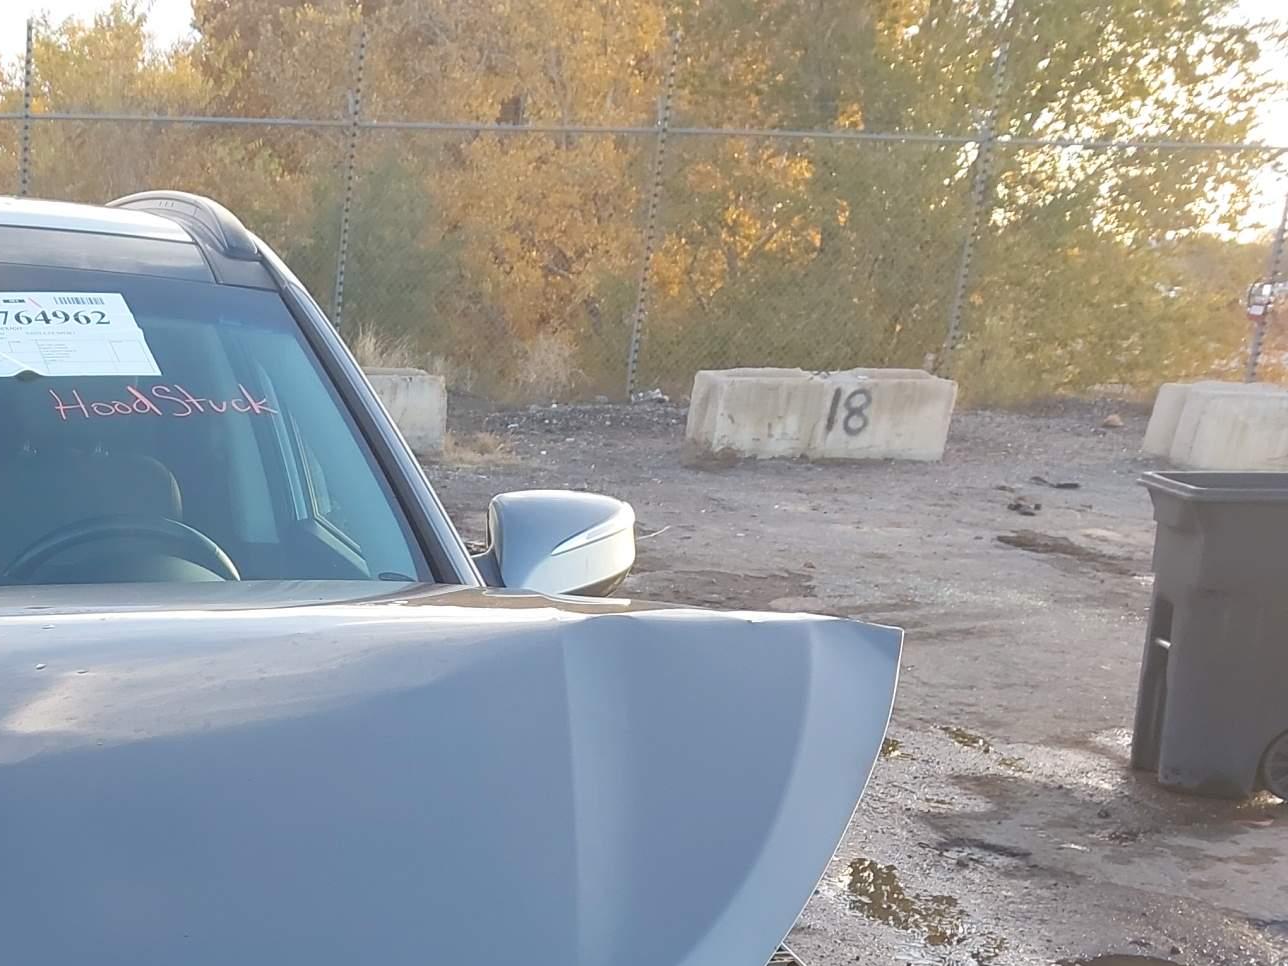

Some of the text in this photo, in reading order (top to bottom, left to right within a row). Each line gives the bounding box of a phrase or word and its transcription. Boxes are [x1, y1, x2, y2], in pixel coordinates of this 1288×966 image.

[48, 382, 279, 420] Hood Stuck
[825, 387, 873, 436] 18
